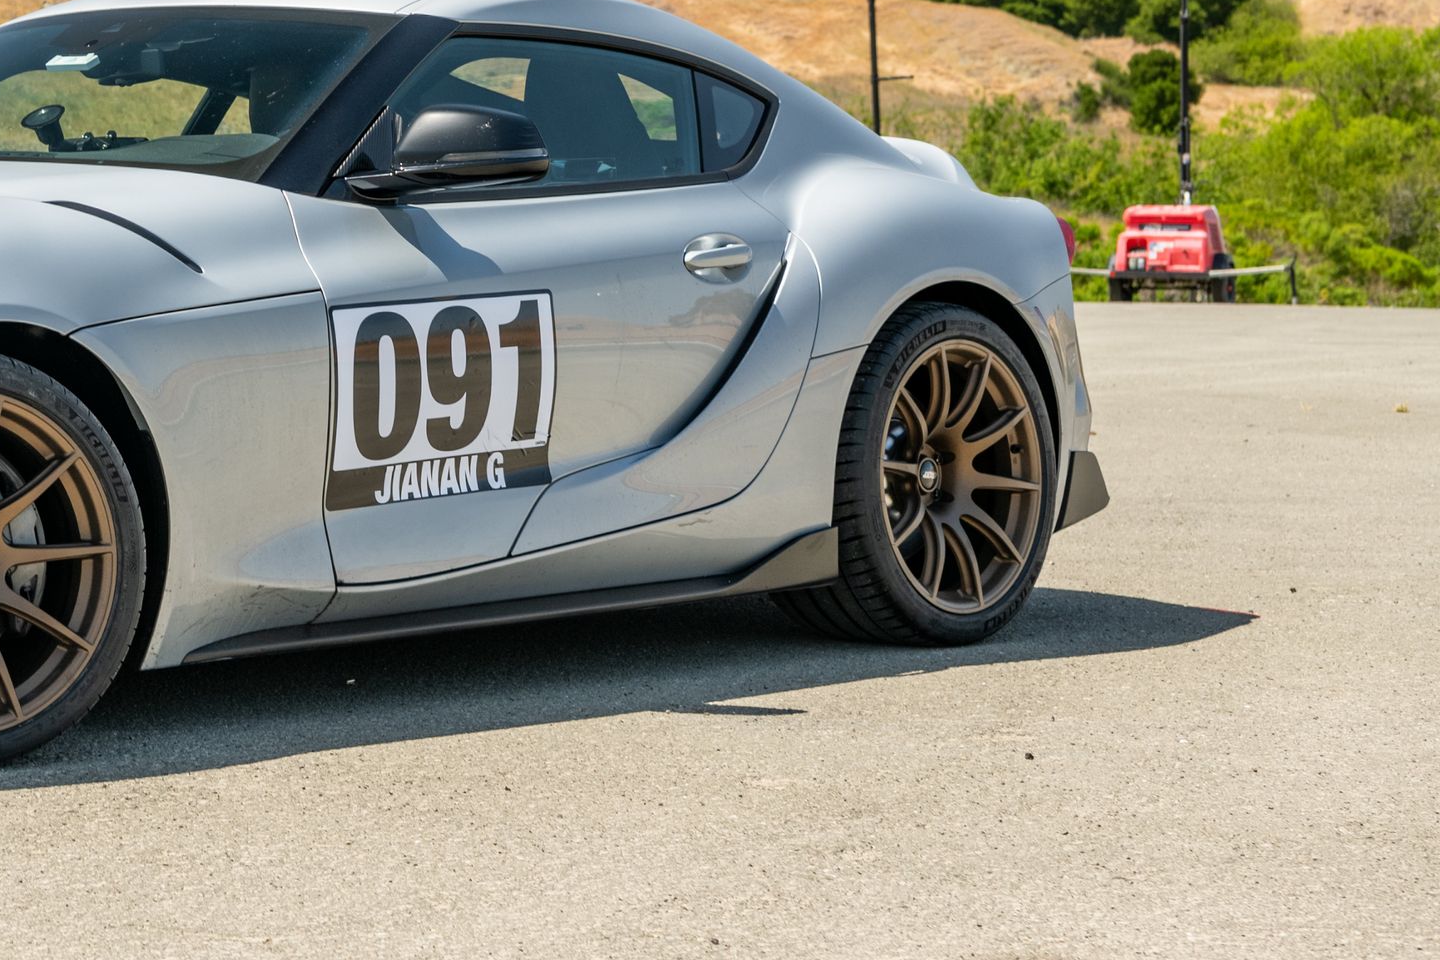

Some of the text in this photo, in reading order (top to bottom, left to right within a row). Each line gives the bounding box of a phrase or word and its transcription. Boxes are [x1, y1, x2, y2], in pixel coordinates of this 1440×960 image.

[896, 320, 946, 371] MICHELIN
[353, 299, 542, 461] 091
[374, 452, 507, 504] JIANAN G
